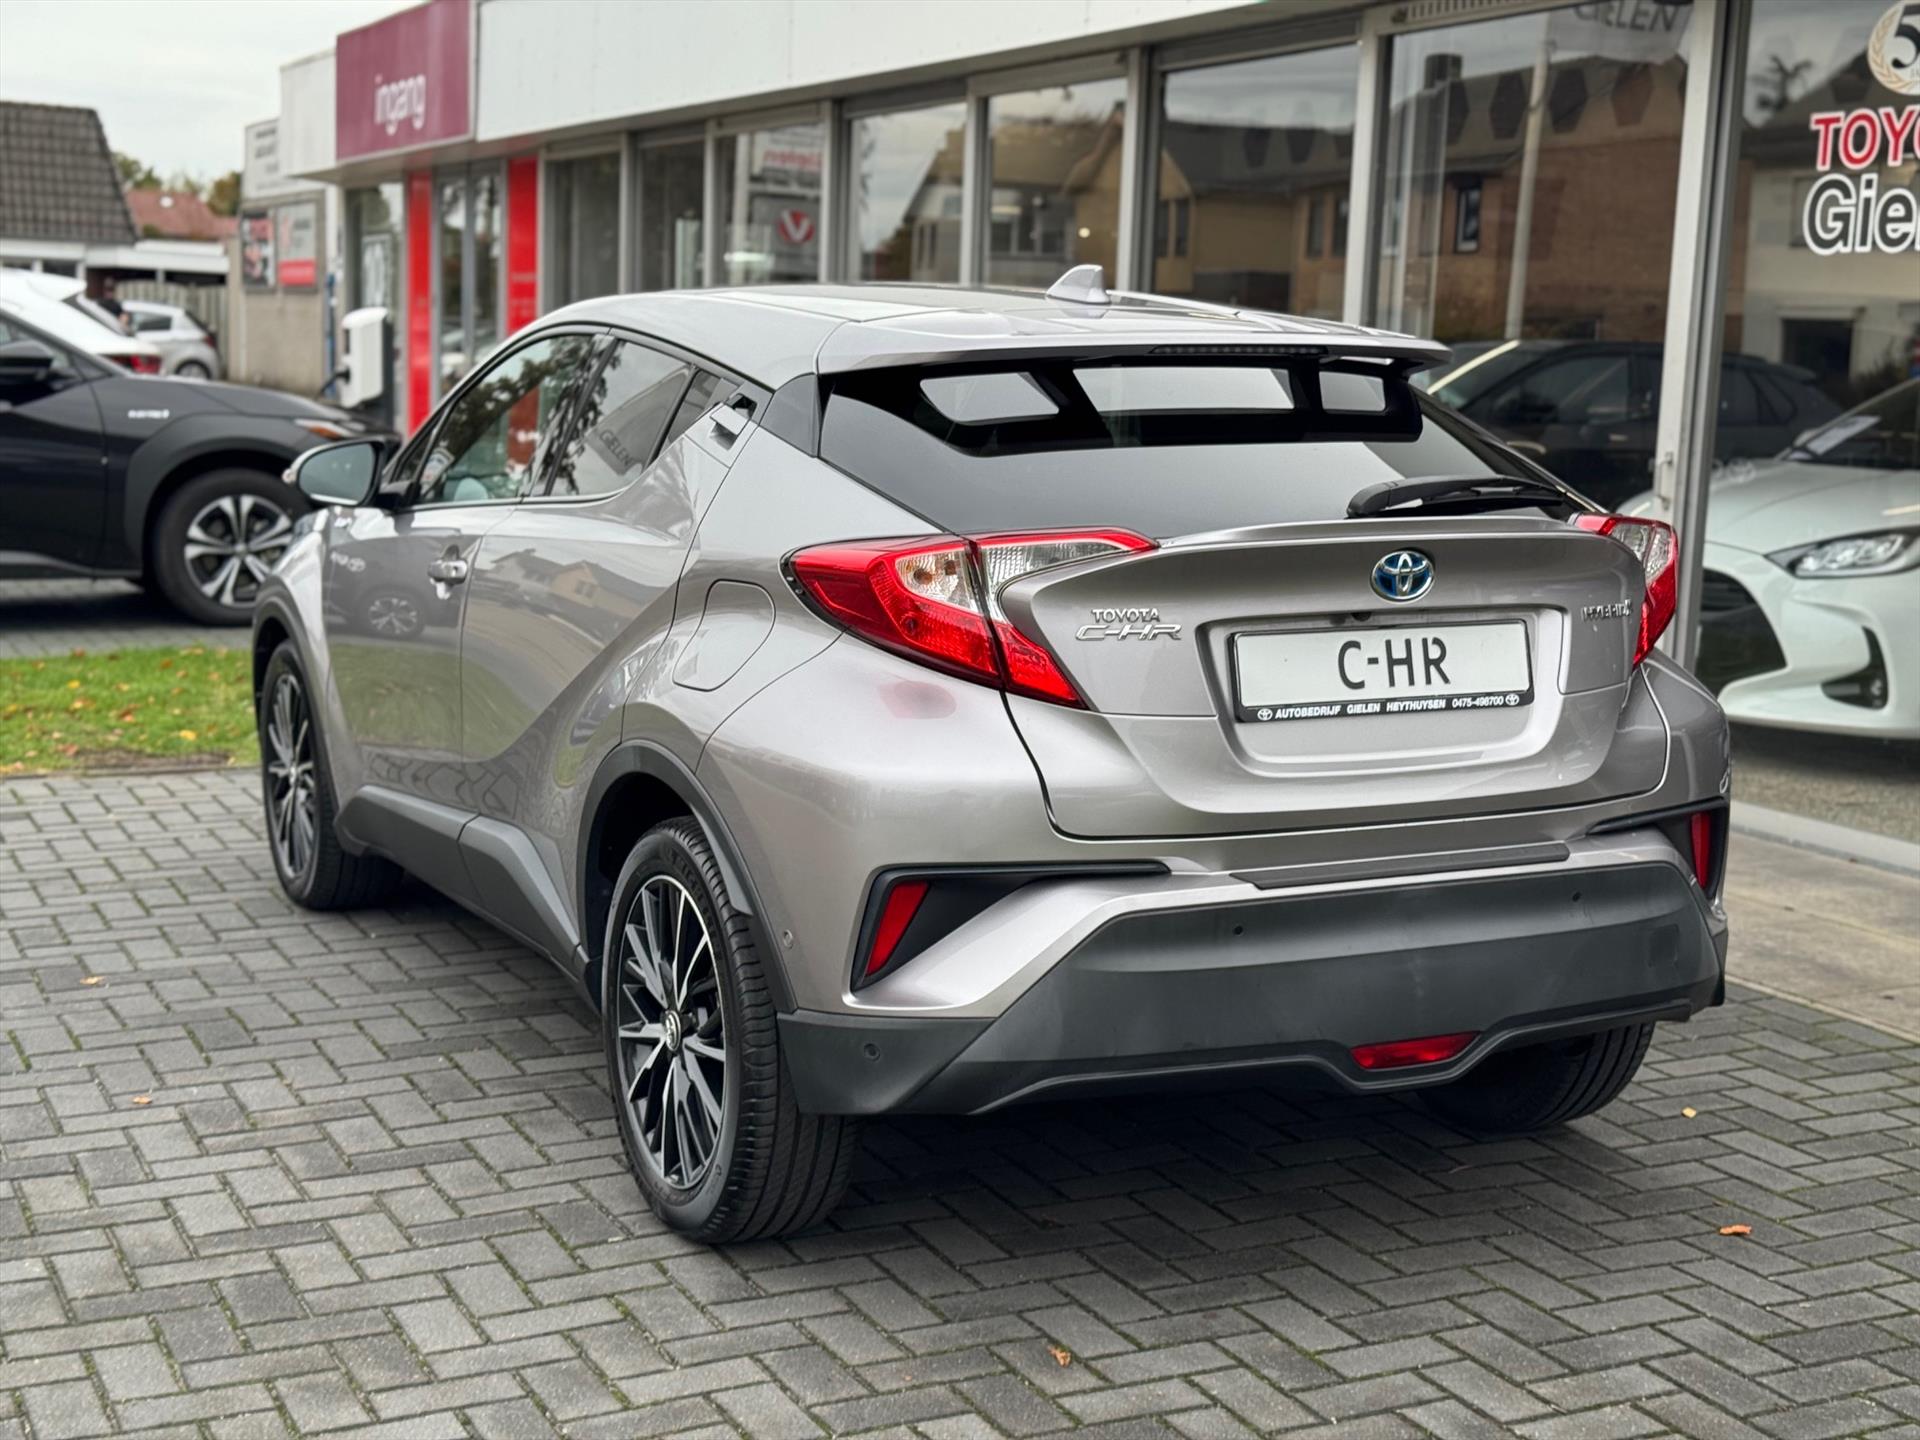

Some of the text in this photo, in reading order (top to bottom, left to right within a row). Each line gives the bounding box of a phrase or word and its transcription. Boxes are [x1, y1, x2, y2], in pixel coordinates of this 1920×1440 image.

[374, 73, 427, 136] ingang
[1809, 104, 1920, 172] TOY
[1802, 172, 1920, 256] Gie
[1075, 624, 1182, 641] C-HR
[1091, 608, 1160, 623] TOYOTA
[1337, 636, 1451, 690] C-HR
[1275, 705, 1341, 719] AUTOBEDRIJF
[1346, 702, 1381, 714] GIELEN
[1386, 698, 1446, 712] HEYTHUYSEN
